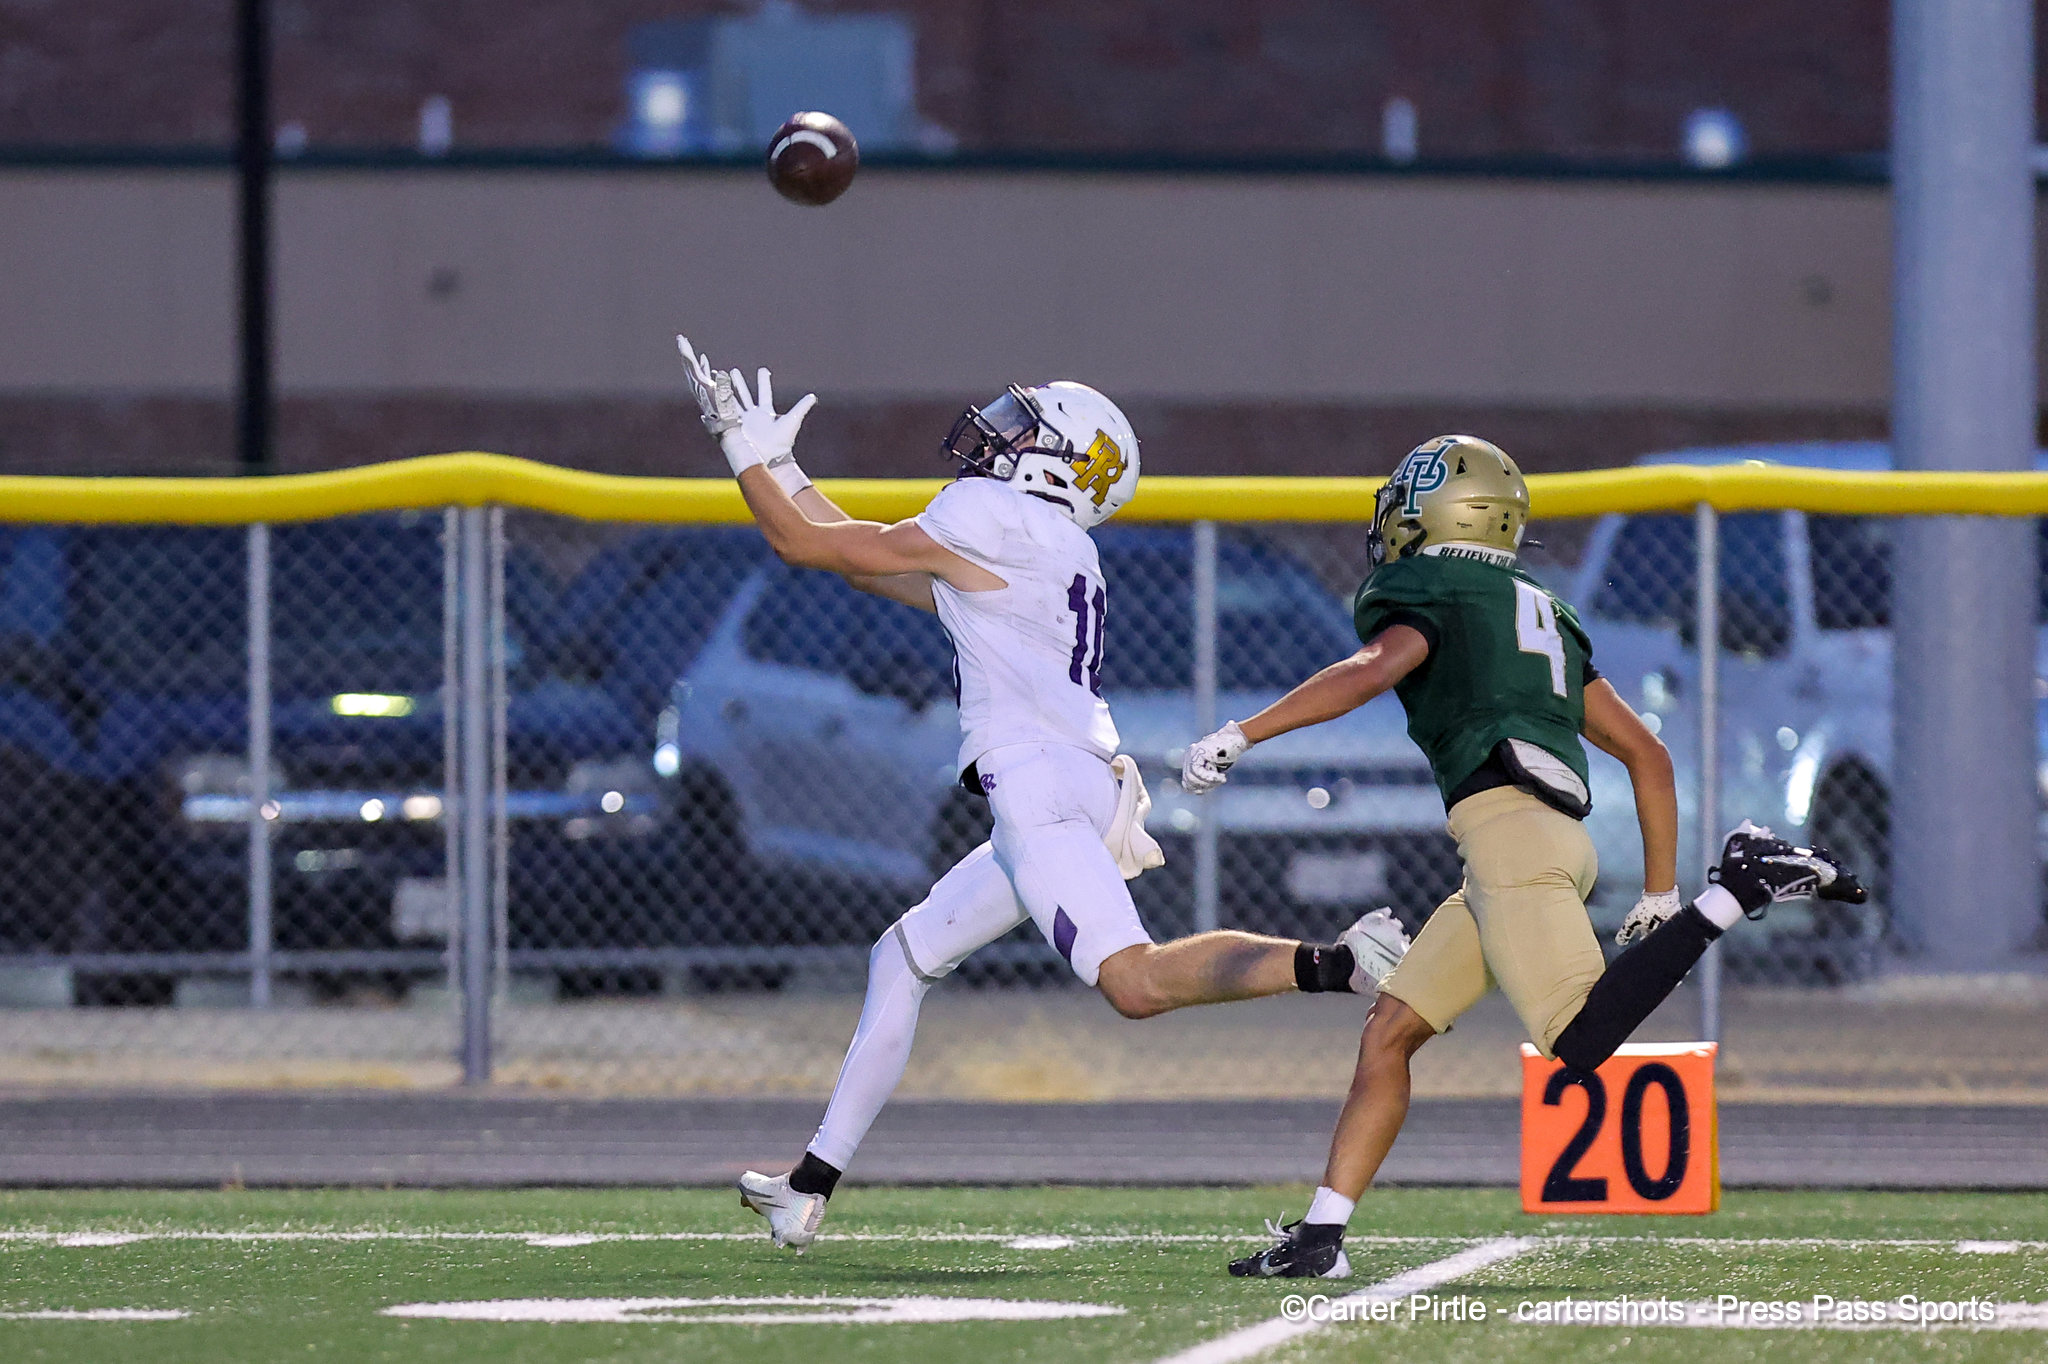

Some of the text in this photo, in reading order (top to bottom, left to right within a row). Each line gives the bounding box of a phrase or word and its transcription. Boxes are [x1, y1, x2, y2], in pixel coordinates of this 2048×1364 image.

[1438, 546, 1495, 565] BELIEVE
[1512, 577, 1567, 698] 4
[1541, 1062, 1690, 1202] 20
